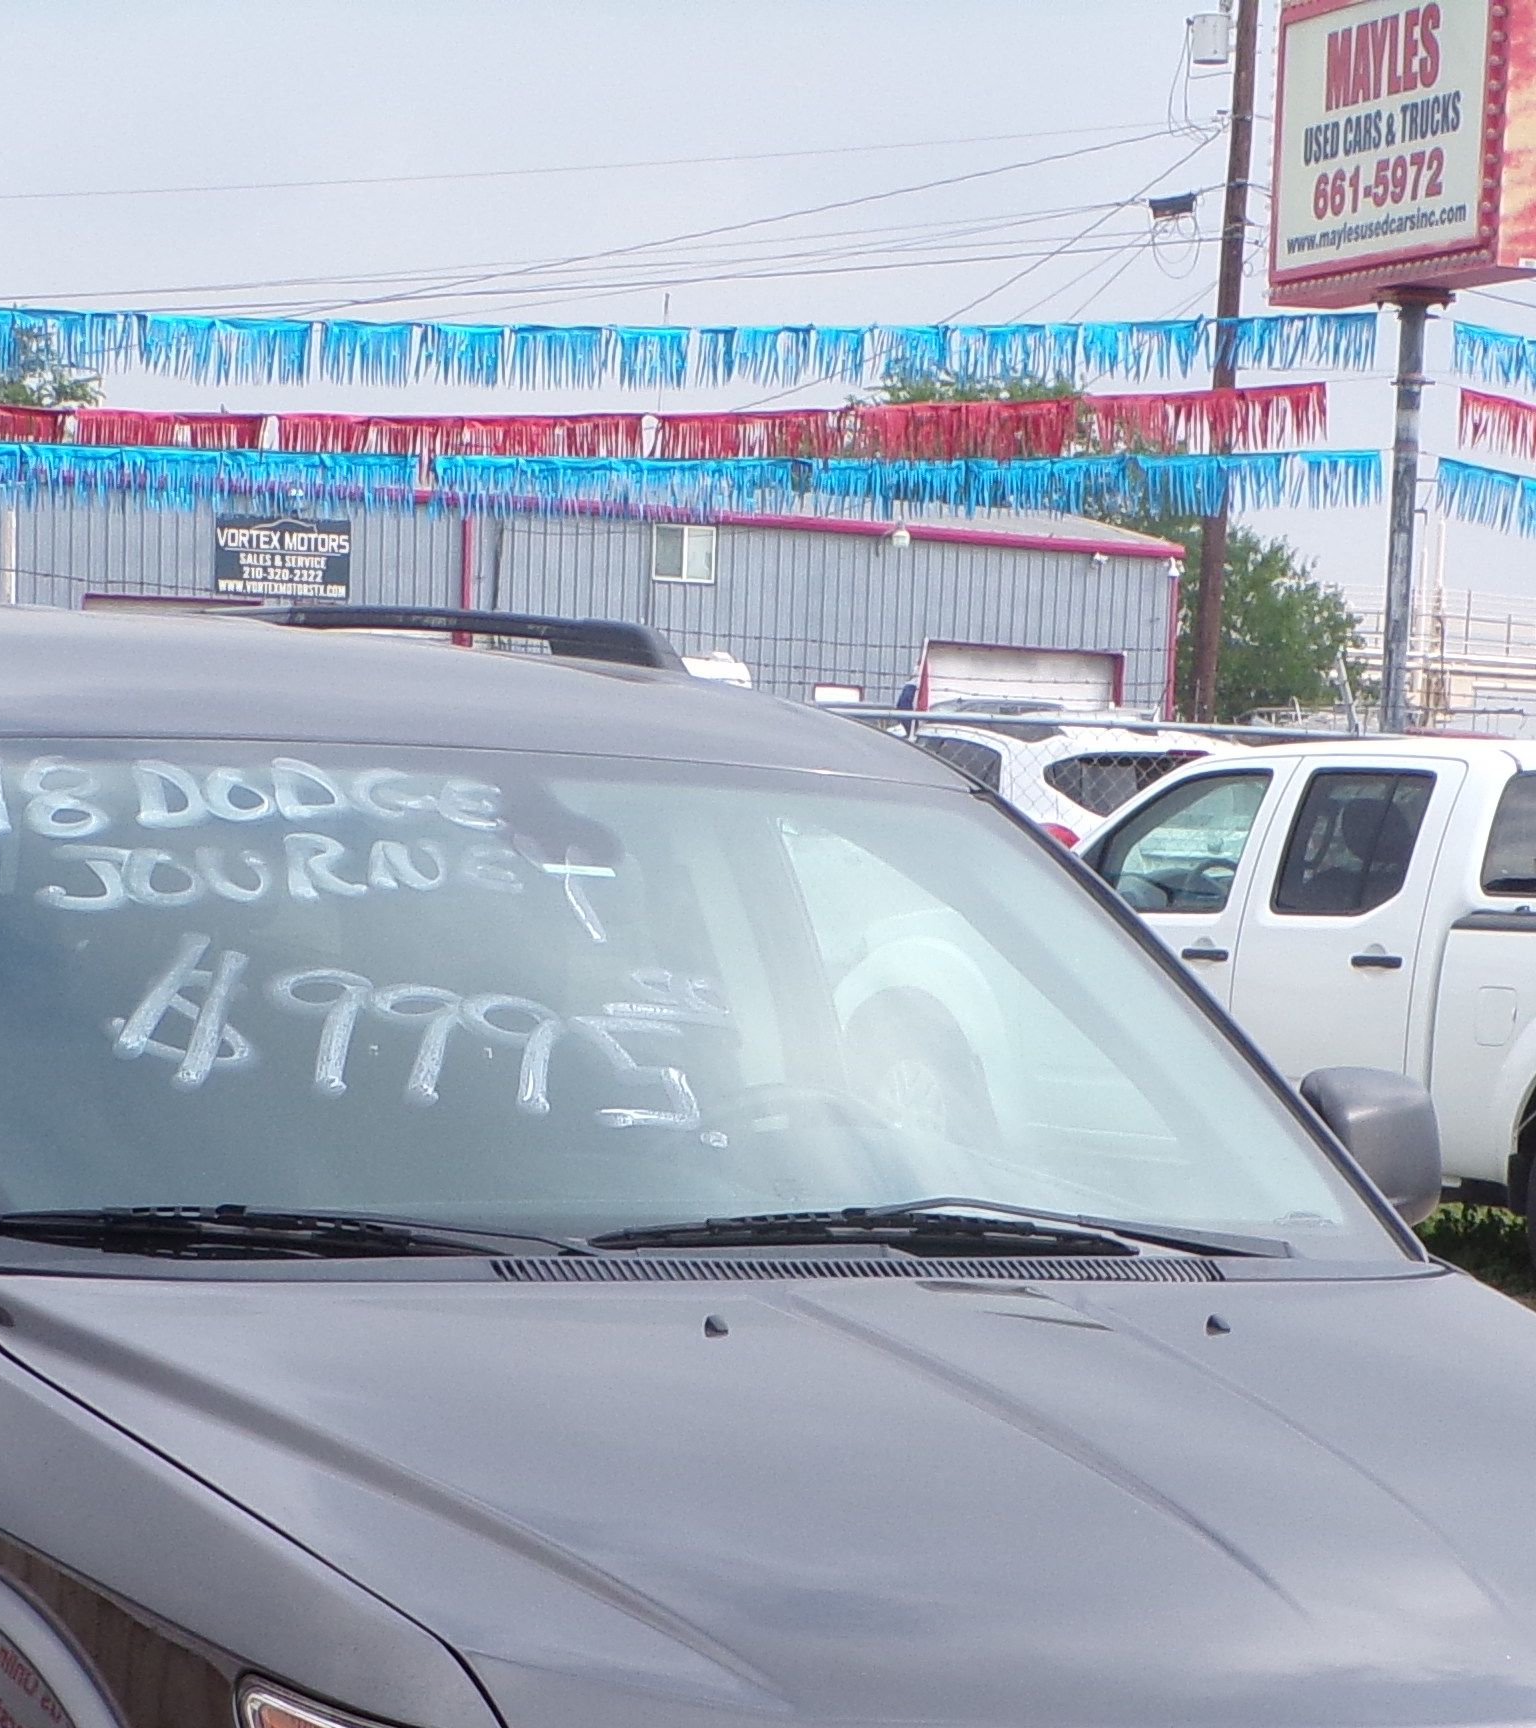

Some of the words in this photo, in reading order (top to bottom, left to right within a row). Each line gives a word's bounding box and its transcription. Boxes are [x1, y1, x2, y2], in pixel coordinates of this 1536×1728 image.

[1325, 2, 1441, 112] MAYLES
[1304, 120, 1341, 165] USED
[1343, 109, 1383, 156] CARS
[1385, 113, 1396, 147] &
[1400, 91, 1462, 144] TRUCKS
[1313, 147, 1445, 220] 661-5972
[1286, 203, 1467, 254] www.maylesusedcarsinc.com
[217, 528, 280, 550] VORTEX
[284, 530, 350, 553] MOTORS
[239, 552, 272, 567] SALES
[274, 554, 282, 567] &
[285, 554, 327, 569] SERVICE
[242, 568, 324, 582] 210-320-2322
[134, 756, 507, 832] DODGE
